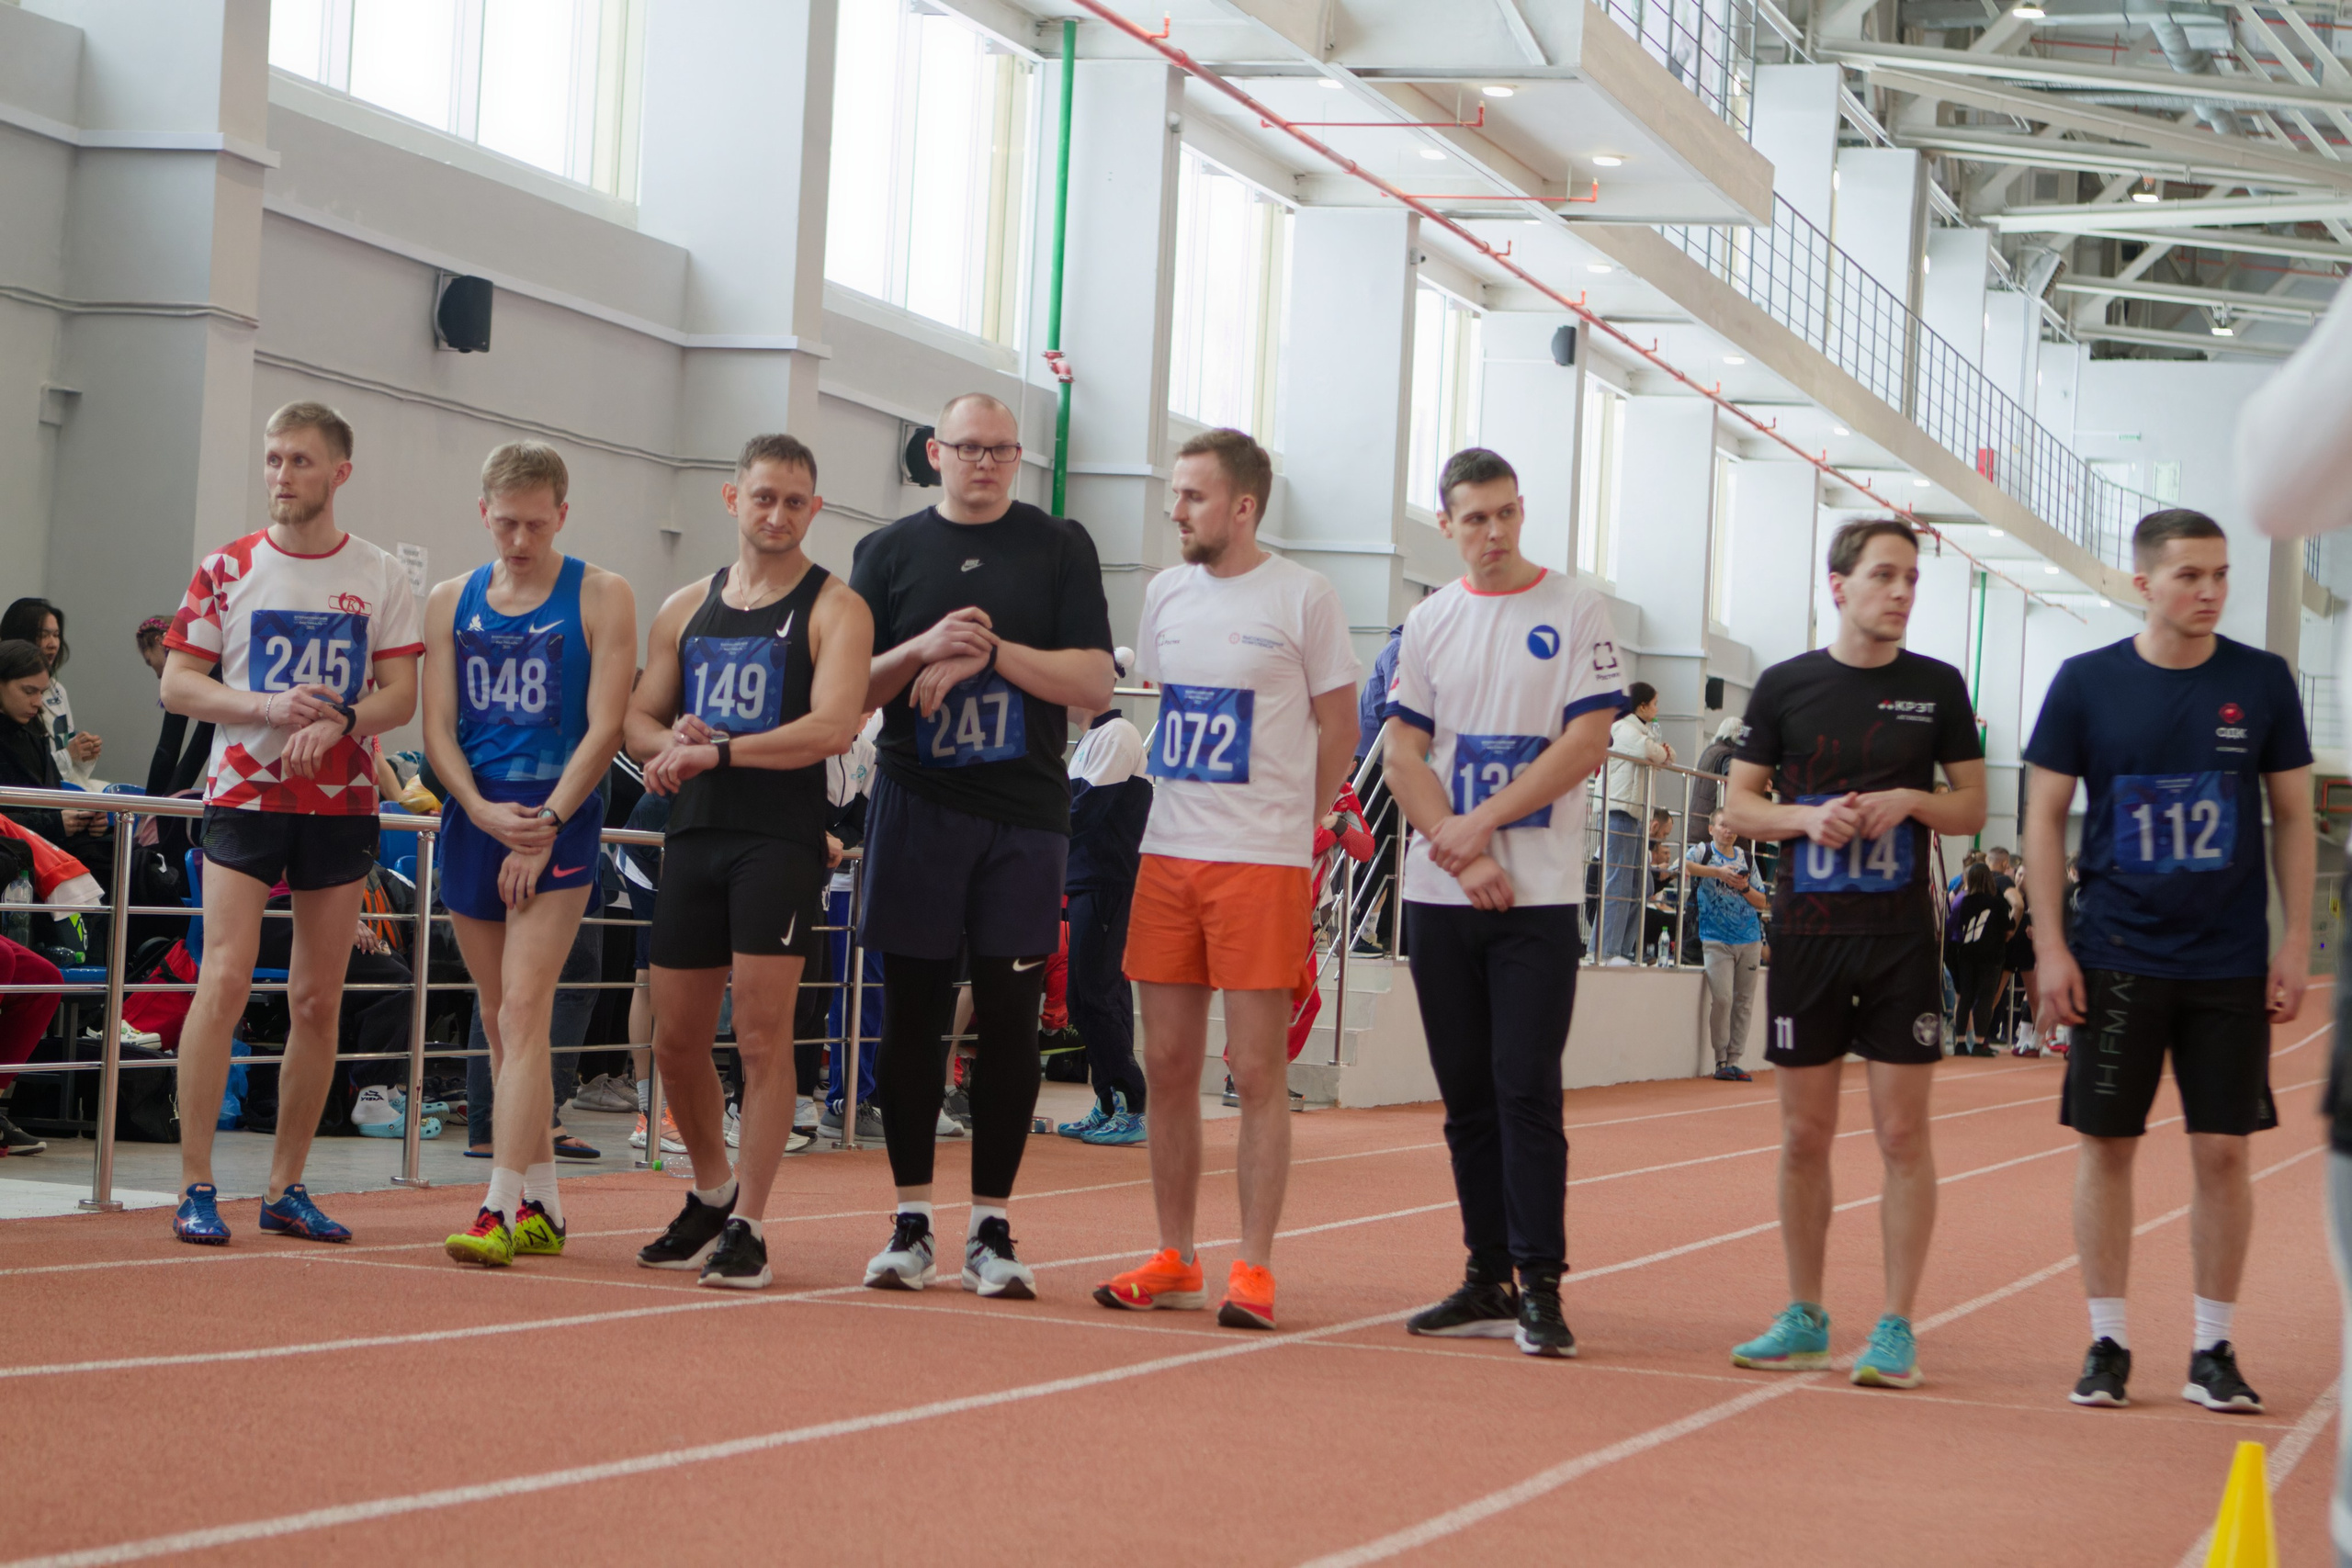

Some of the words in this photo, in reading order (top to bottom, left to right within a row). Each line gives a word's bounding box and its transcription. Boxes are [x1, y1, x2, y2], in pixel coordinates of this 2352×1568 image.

[265, 636, 351, 694] 245
[466, 656, 548, 715] 048
[695, 661, 767, 719] 149
[927, 692, 1009, 758] 247
[1894, 700, 1936, 714] КРЭТ
[1163, 710, 1237, 772] 072
[1459, 761, 1530, 815] 13
[1806, 828, 1899, 880] 014
[2132, 798, 2222, 862] 112
[1774, 1015, 1794, 1049] 11
